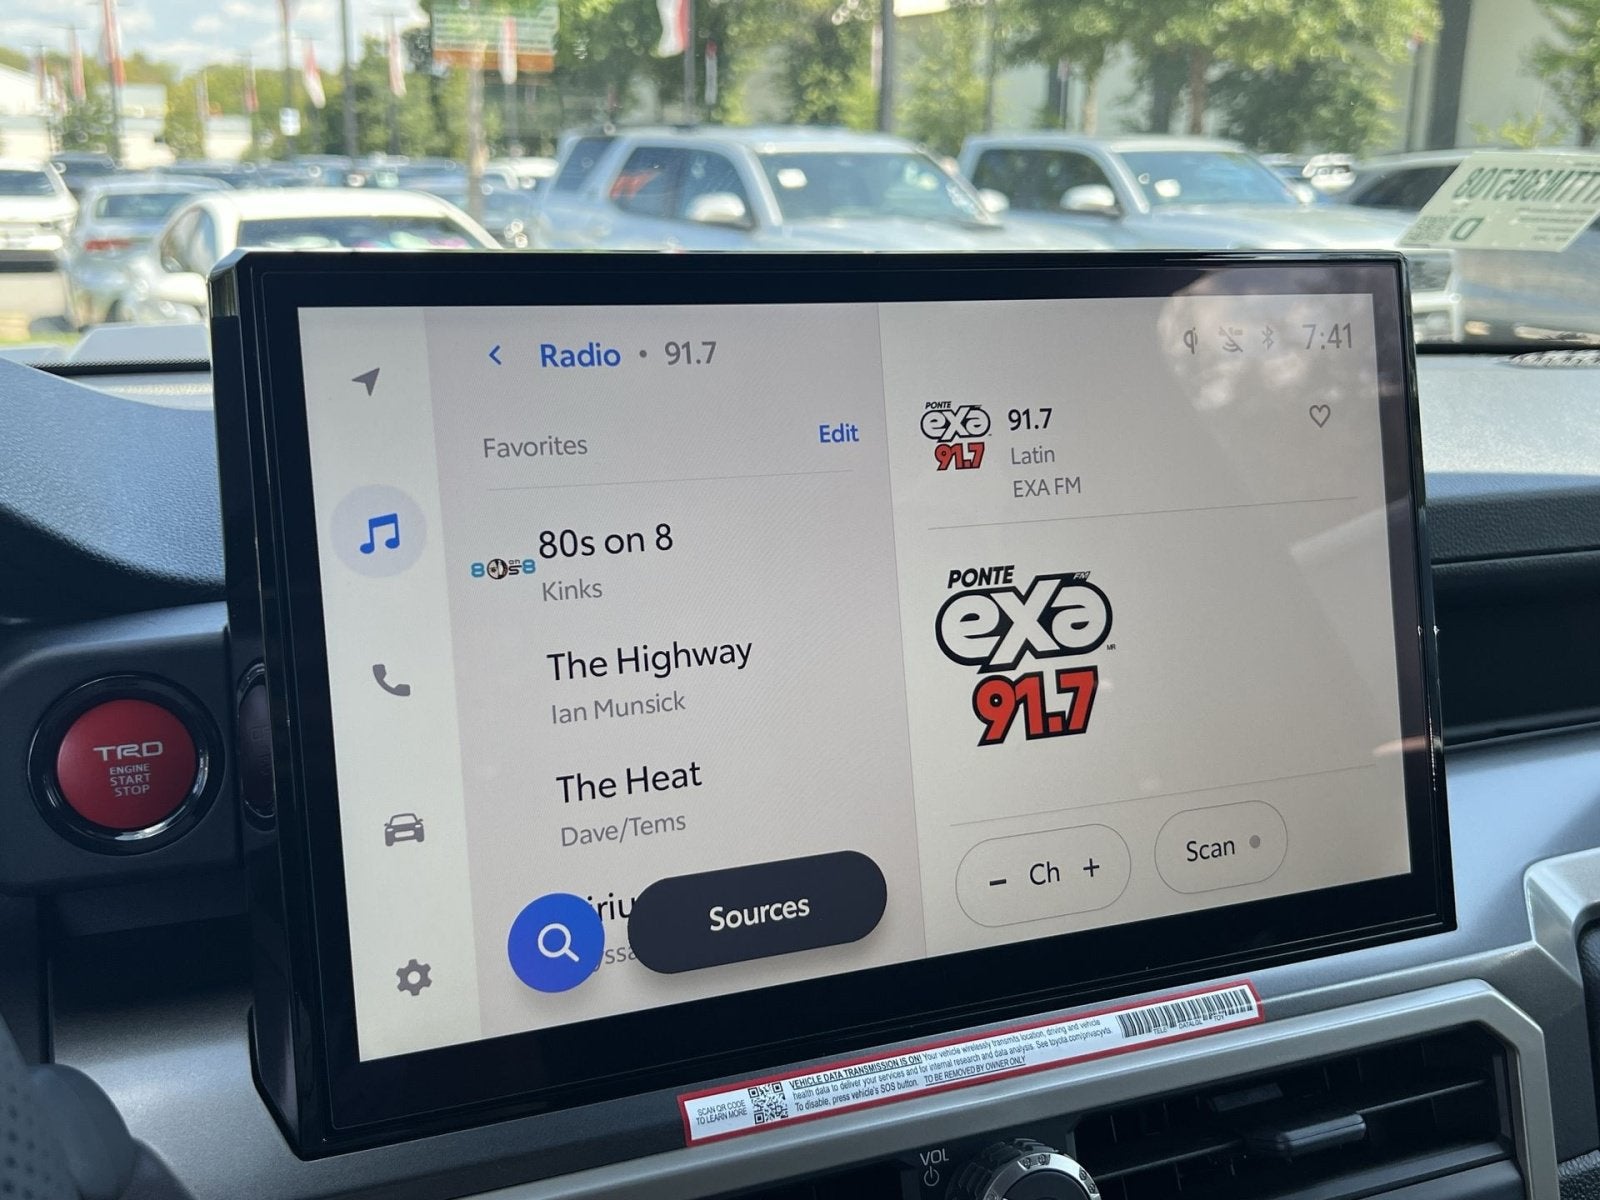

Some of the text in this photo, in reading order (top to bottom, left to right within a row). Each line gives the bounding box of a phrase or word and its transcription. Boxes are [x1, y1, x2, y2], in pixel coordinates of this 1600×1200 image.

[1302, 322, 1352, 350] 7:41
[540, 341, 717, 369] Radio 91.7
[925, 401, 951, 409] PONTE
[1008, 408, 1052, 432] 91.7
[818, 423, 860, 444] Edit
[483, 436, 588, 458] Favorites
[935, 442, 985, 471] 91.7
[1011, 446, 1055, 466] Latin
[1013, 477, 1081, 498] EXA FM
[538, 523, 674, 559] 80s on 8
[947, 565, 1015, 589] PONTE
[541, 578, 603, 602] Kinks
[547, 640, 753, 681] The Highway
[551, 690, 686, 725] Ian Munsick
[972, 665, 1099, 747] 91.7
[92, 741, 163, 762] TRD
[109, 763, 150, 775] ENGINE
[110, 773, 151, 787] START
[114, 784, 150, 797] STOP
[556, 761, 703, 804] The Heat
[560, 814, 687, 848] Dave/Tems
[1186, 839, 1236, 862] Scan
[1029, 861, 1061, 886] Ch
[587, 892, 635, 920] riu
[709, 898, 810, 931] Sources
[790, 1075, 822, 1088] VEHICLE
[823, 1070, 843, 1082] DATA
[844, 1059, 899, 1077] TRANSMISSION
[900, 1057, 907, 1065] IS
[908, 1054, 922, 1063] ON!
[923, 1052, 938, 1061] Your
[938, 1047, 960, 1058] vehicle
[961, 1041, 991, 1054] wirelessly
[992, 1035, 1020, 1046] transmits
[1046, 1026, 1067, 1037] driving
[1067, 1023, 1079, 1031] and
[1080, 1019, 1101, 1028] vehicle
[792, 1088, 814, 1100] health
[815, 1085, 830, 1095] data
[831, 1083, 839, 1091] to
[839, 1078, 861, 1090] deliver
[863, 1076, 878, 1087] your
[878, 1070, 905, 1082] services
[906, 1067, 918, 1076] and
[919, 1065, 928, 1073] for
[929, 1060, 953, 1071] internal
[953, 1054, 981, 1065] research
[981, 1051, 994, 1060] and
[994, 1048, 1008, 1057] data
[1036, 1039, 1049, 1048] See
[795, 1102, 804, 1112] To
[832, 1094, 851, 1105] press
[851, 1086, 880, 1099] vehicle's
[880, 1082, 896, 1093] SOS
[924, 1075, 934, 1083] TO
[934, 1073, 943, 1081] BE
[943, 1066, 976, 1079] REMOVED
[976, 1064, 985, 1072] BY
[985, 1059, 1009, 1070] OWNER
[1009, 1055, 1027, 1064] ONLY
[696, 1107, 748, 1125] TO LEARN MORE
[697, 1099, 746, 1116] SCAN QR CODE
[919, 1148, 949, 1166] VOL
